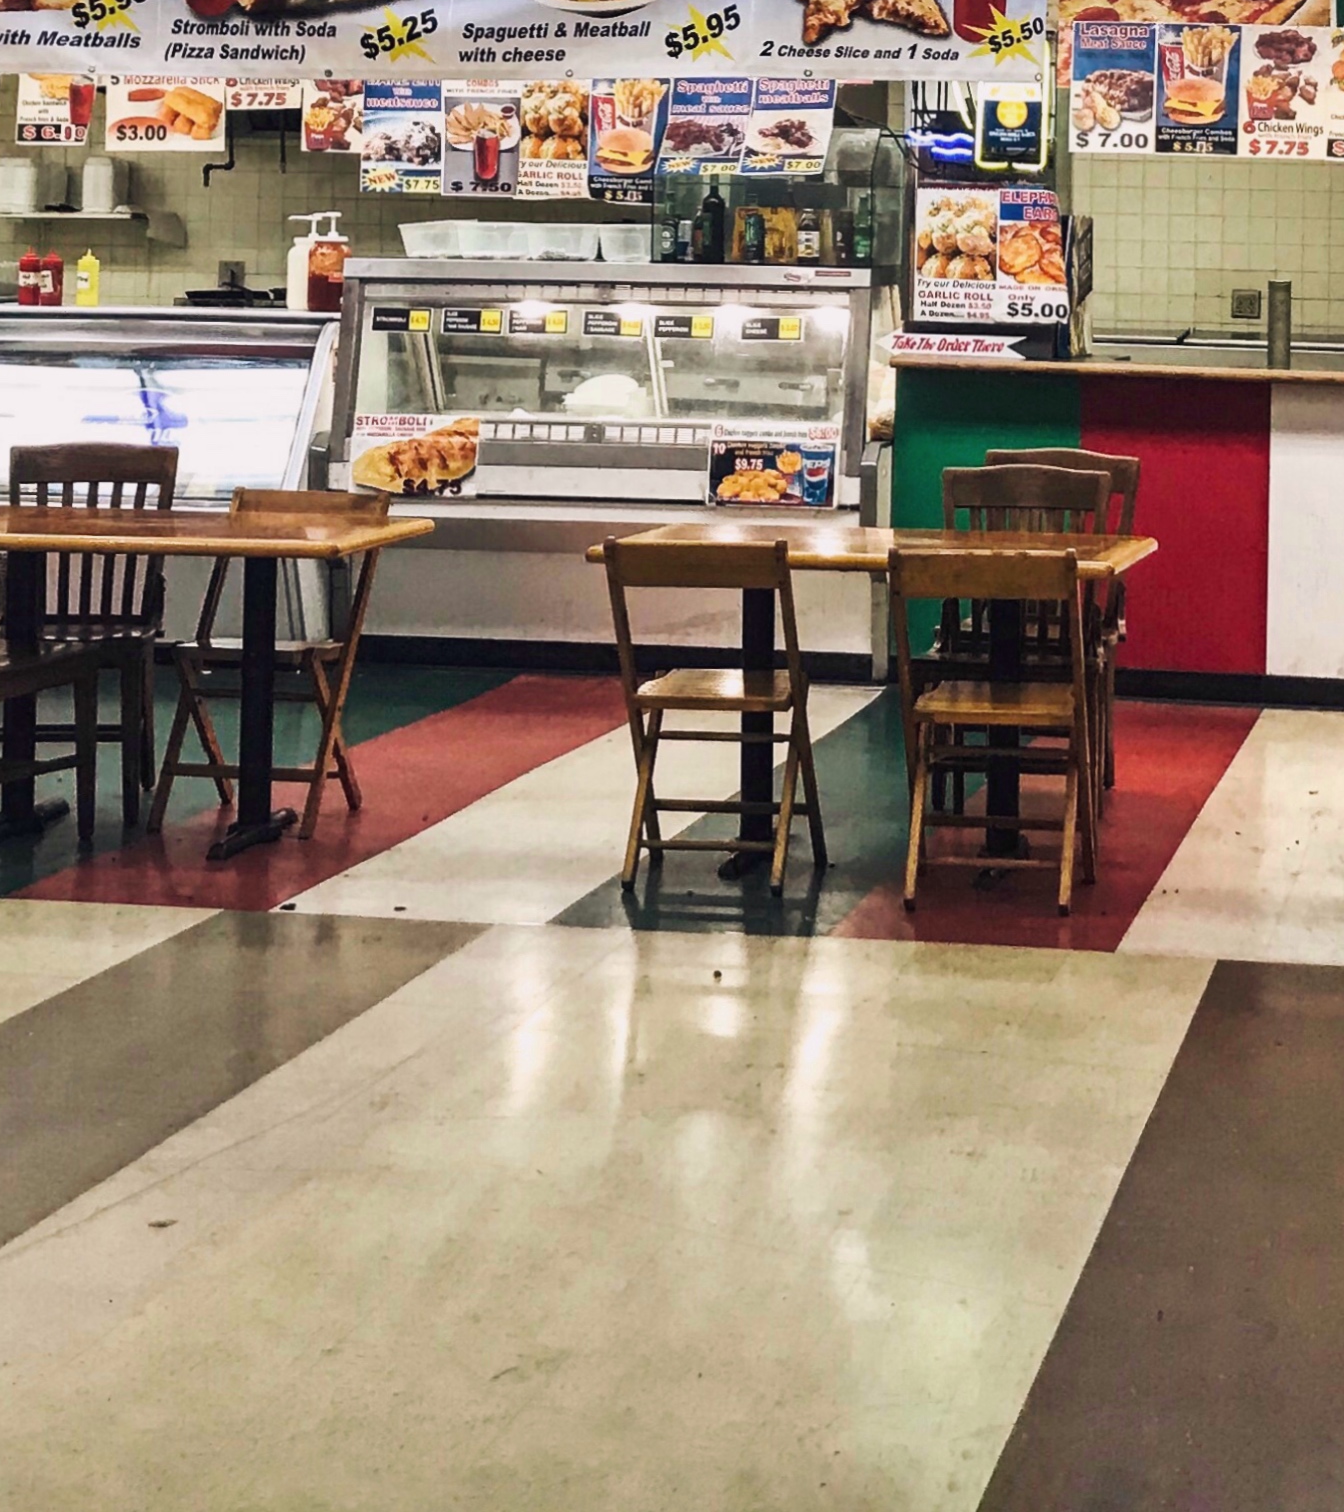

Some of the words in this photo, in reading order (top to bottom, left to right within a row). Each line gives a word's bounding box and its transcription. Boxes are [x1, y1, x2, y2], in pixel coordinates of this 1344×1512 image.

[172, 19, 249, 36] Stromboli
[256, 20, 290, 37] with
[296, 21, 336, 38] Soda
[360, 9, 438, 60] $5.25
[462, 22, 548, 42] Spaguetti
[555, 24, 567, 38] &
[574, 21, 651, 38] Meatball
[664, 4, 741, 59] $5.95
[988, 17, 1044, 53] $5.50
[1080, 23, 1149, 39] Lasagna
[37, 31, 141, 48] Meatballs
[1081, 39, 1109, 49] Meat
[1111, 39, 1146, 49] Sauce
[165, 43, 214, 61] (Pizza
[219, 44, 305, 64] Sandwich)
[458, 47, 496, 62] with
[502, 48, 566, 62] cheese
[759, 40, 774, 57] 2
[777, 46, 830, 58] Cheese
[835, 45, 869, 58] Slice
[874, 46, 900, 59] and
[907, 44, 917, 58] 1
[922, 48, 959, 60] Soda
[123, 75, 187, 84] Mozzarella
[758, 79, 830, 92] Spaghetti
[677, 80, 749, 95] Spaghetti
[246, 92, 287, 106] 7.75
[116, 125, 167, 141] $3.00
[1243, 121, 1256, 134] 6
[1257, 121, 1294, 134] Chicken
[1295, 123, 1324, 135] Wings
[1098, 134, 1148, 148] 7.00
[1265, 140, 1309, 155] 7.75
[546, 159, 587, 170] Delicious
[786, 161, 821, 170] $7.00
[368, 172, 397, 185] NEW
[557, 172, 583, 181] ROLL
[405, 178, 440, 190] $7.75
[917, 278, 933, 289] Try
[952, 279, 996, 290] Delicious
[918, 290, 961, 300] GARLIC
[963, 292, 993, 301] ROLL
[920, 300, 935, 308] Half
[937, 301, 966, 309] Dozen
[1007, 302, 1068, 318] $5.00
[891, 335, 916, 350] Take
[916, 337, 935, 351] The
[937, 338, 969, 352] Order
[972, 338, 1005, 353] There
[713, 443, 726, 454] 10
[735, 458, 763, 470] $9.75
